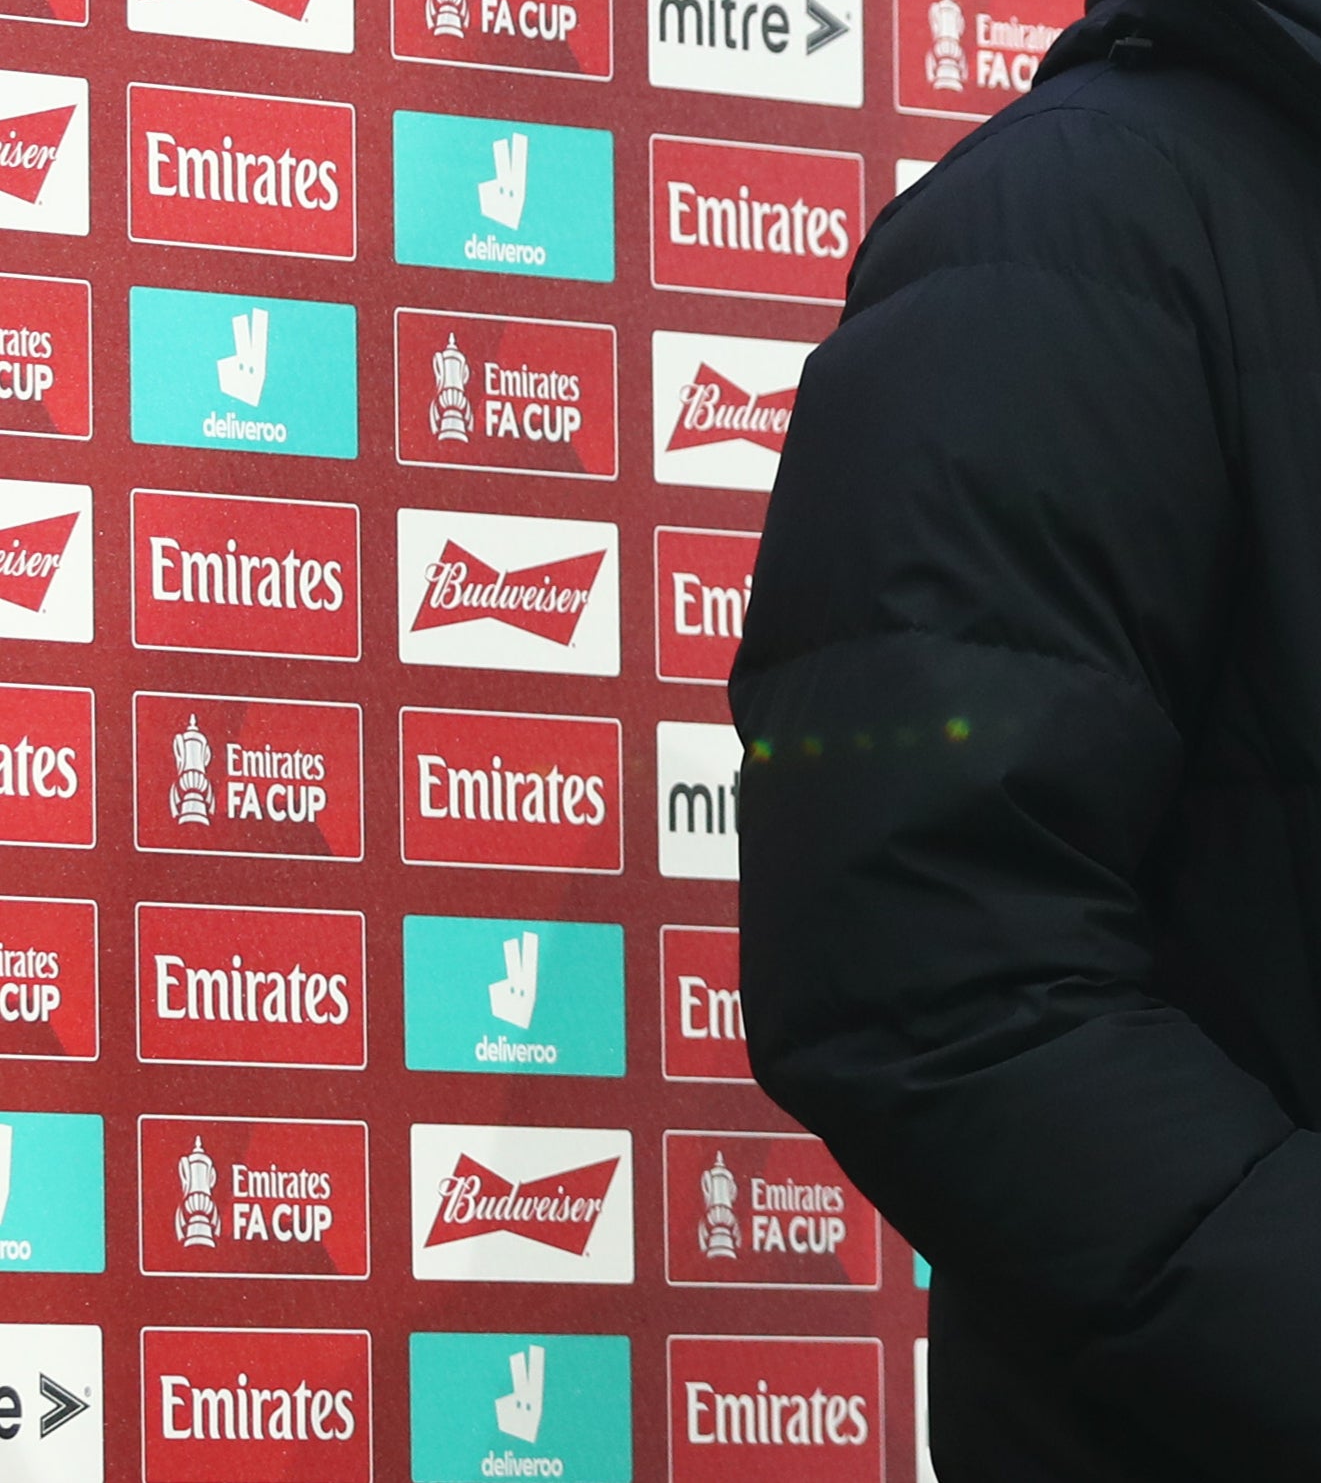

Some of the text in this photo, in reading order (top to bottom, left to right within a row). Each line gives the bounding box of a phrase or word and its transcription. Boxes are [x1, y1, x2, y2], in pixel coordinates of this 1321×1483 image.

[519, 1, 576, 40] CUP
[977, 49, 1011, 91] FA
[146, 132, 338, 210] Emirates
[668, 182, 848, 258] Emirates
[465, 234, 546, 265] deliveroo
[485, 363, 579, 401] Emirates
[203, 412, 286, 442] deliveroo
[486, 401, 580, 442] FA CUP
[150, 537, 342, 610] Emirates
[423, 558, 590, 615] Budweiser
[227, 744, 324, 780] Emirates
[228, 782, 325, 822] FA CUP
[418, 755, 604, 825] Emirates
[0, 982, 60, 1022] CUP
[155, 955, 348, 1024] Emirates
[475, 1035, 557, 1063] deliveroo
[233, 1165, 330, 1199] Emirates
[438, 1176, 604, 1224] Budweiser
[751, 1178, 843, 1212] Emirates
[234, 1204, 331, 1241] FA CUP
[753, 1216, 845, 1253] FA CUP
[161, 1374, 354, 1440] Emirates
[686, 1380, 867, 1444] Emirates
[481, 1451, 563, 1477] deliveroo
